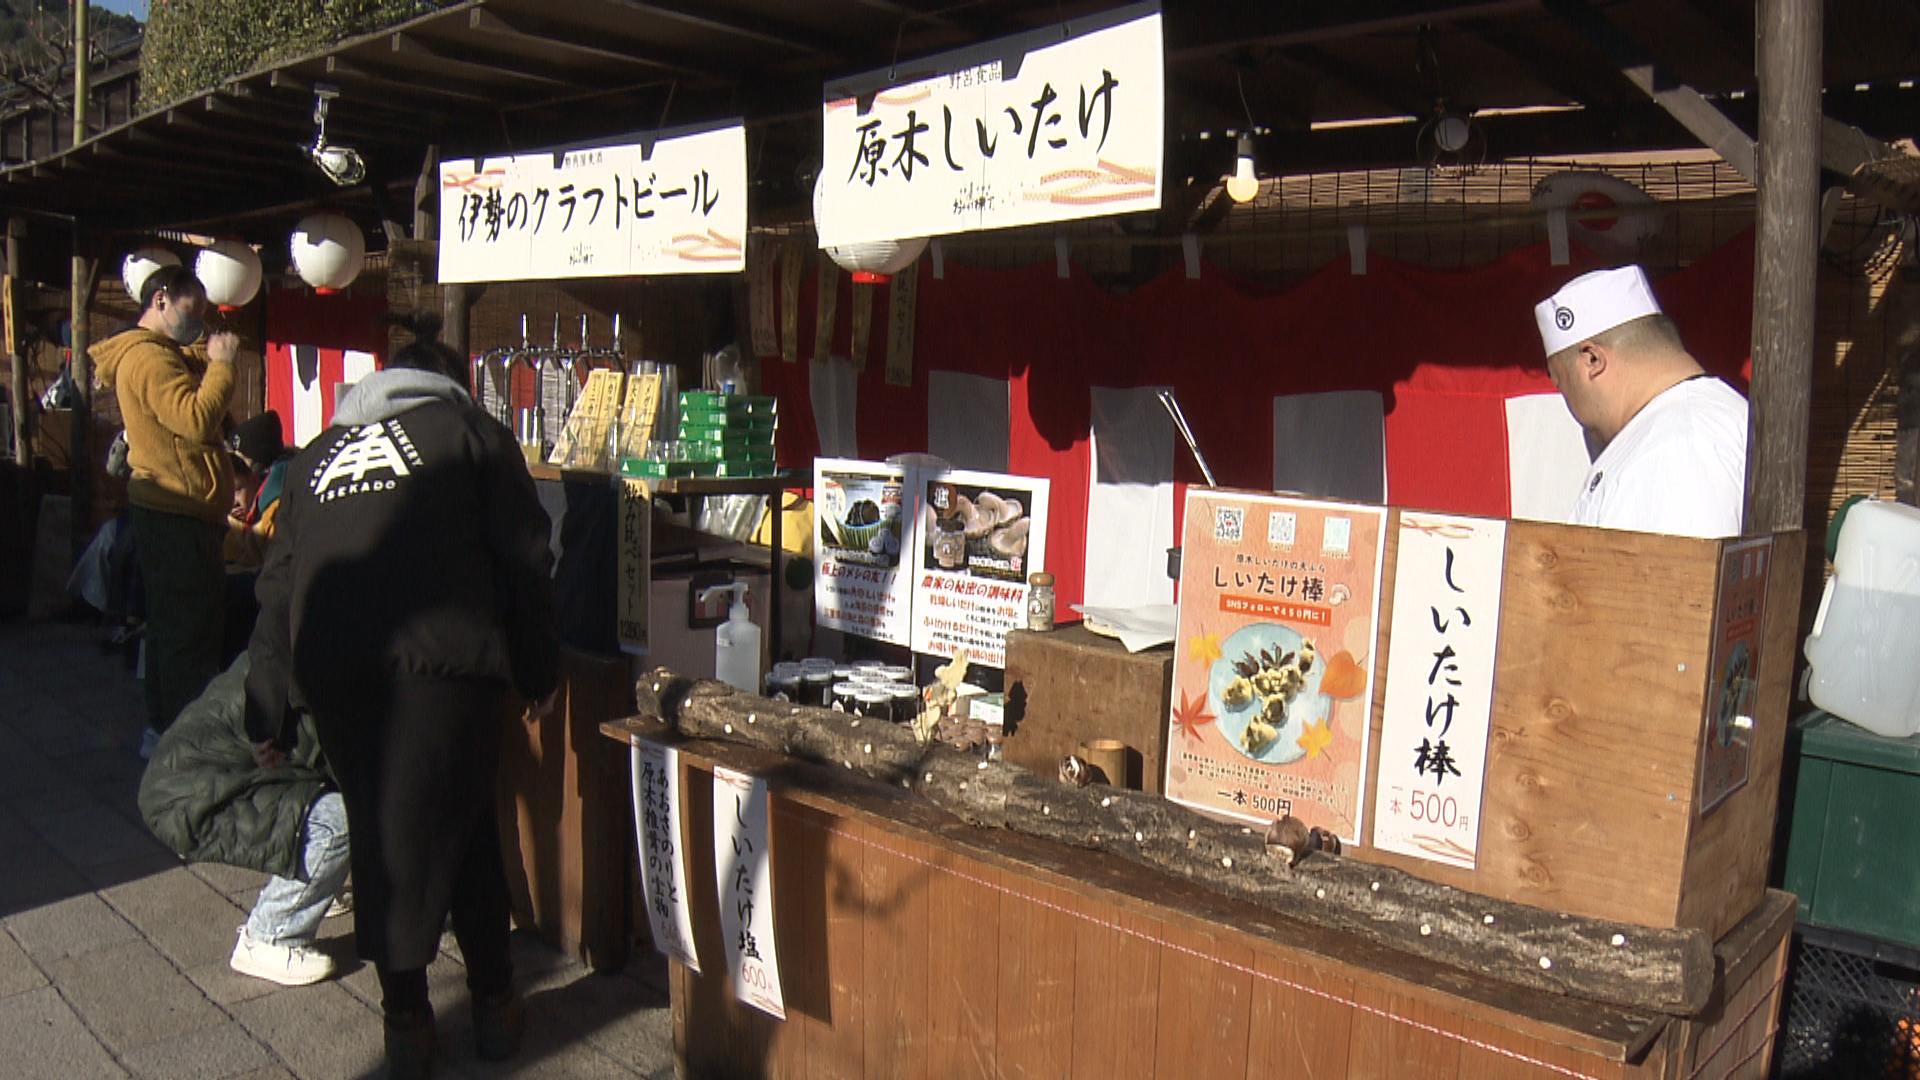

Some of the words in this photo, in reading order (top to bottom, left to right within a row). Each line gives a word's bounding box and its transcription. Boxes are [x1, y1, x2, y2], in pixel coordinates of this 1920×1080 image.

[848, 69, 1119, 187] 原木しいたけ
[459, 169, 719, 243] 伊勢のクラフトビール
[320, 480, 396, 503] ISEKADO
[921, 573, 1023, 604] 農家の秘密の調味料
[1215, 567, 1324, 602] しいたけ棒
[1414, 546, 1472, 787] しいたけ棒
[1217, 789, 1248, 806] 一本
[1253, 796, 1291, 815] 500円
[1410, 790, 1469, 831] 500円
[657, 767, 678, 903] あおさのりと
[731, 794, 764, 964] しいたけ塩
